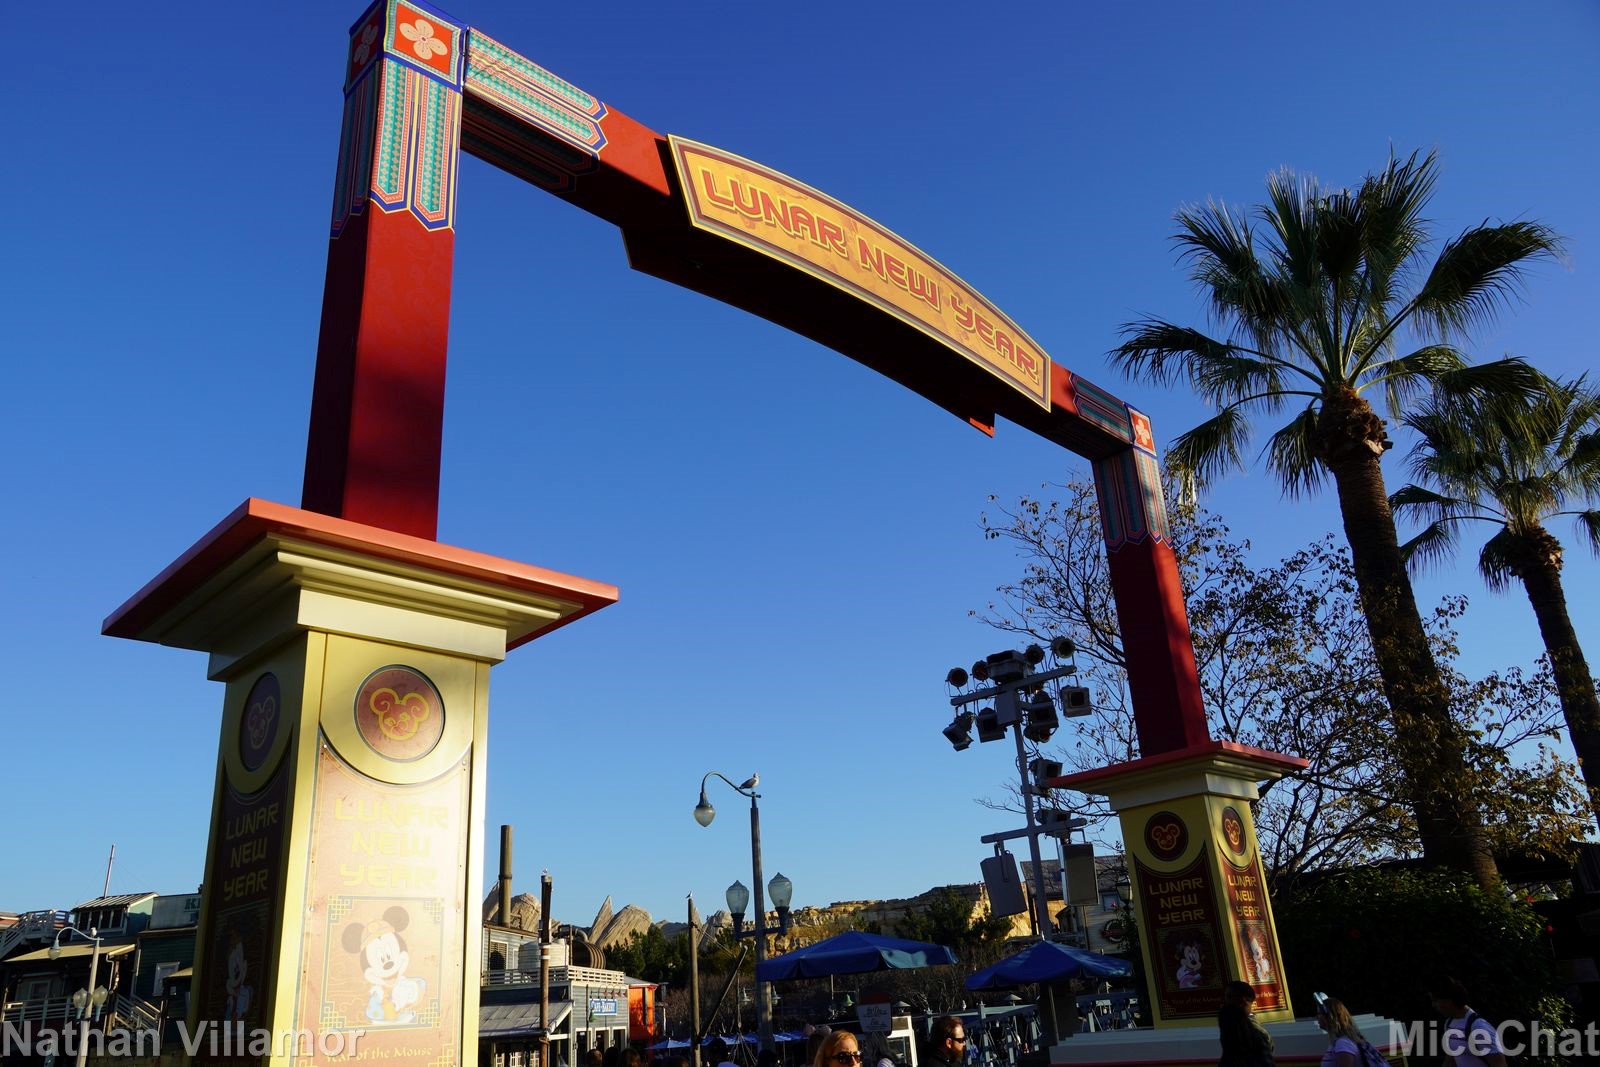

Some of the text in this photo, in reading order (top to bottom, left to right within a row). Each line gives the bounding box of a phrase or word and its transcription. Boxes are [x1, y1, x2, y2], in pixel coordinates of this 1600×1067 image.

[699, 167, 1039, 383] LUNAR NEW YEAR
[226, 801, 280, 840] LUNAR
[335, 797, 449, 829] LUNAR
[230, 836, 268, 869] NEW
[350, 831, 430, 858] NEW
[223, 868, 269, 901] YEAR
[340, 862, 438, 890] YEAR
[1149, 877, 1205, 896] LUNAR
[1228, 874, 1257, 888] LUNAR
[1160, 895, 1198, 910] NEW
[1235, 890, 1256, 902] NEW
[1158, 908, 1206, 925] YEAR
[1236, 905, 1261, 918] YEAR
[372, 1047, 389, 1060] the
[394, 1046, 432, 1058] Mouse
